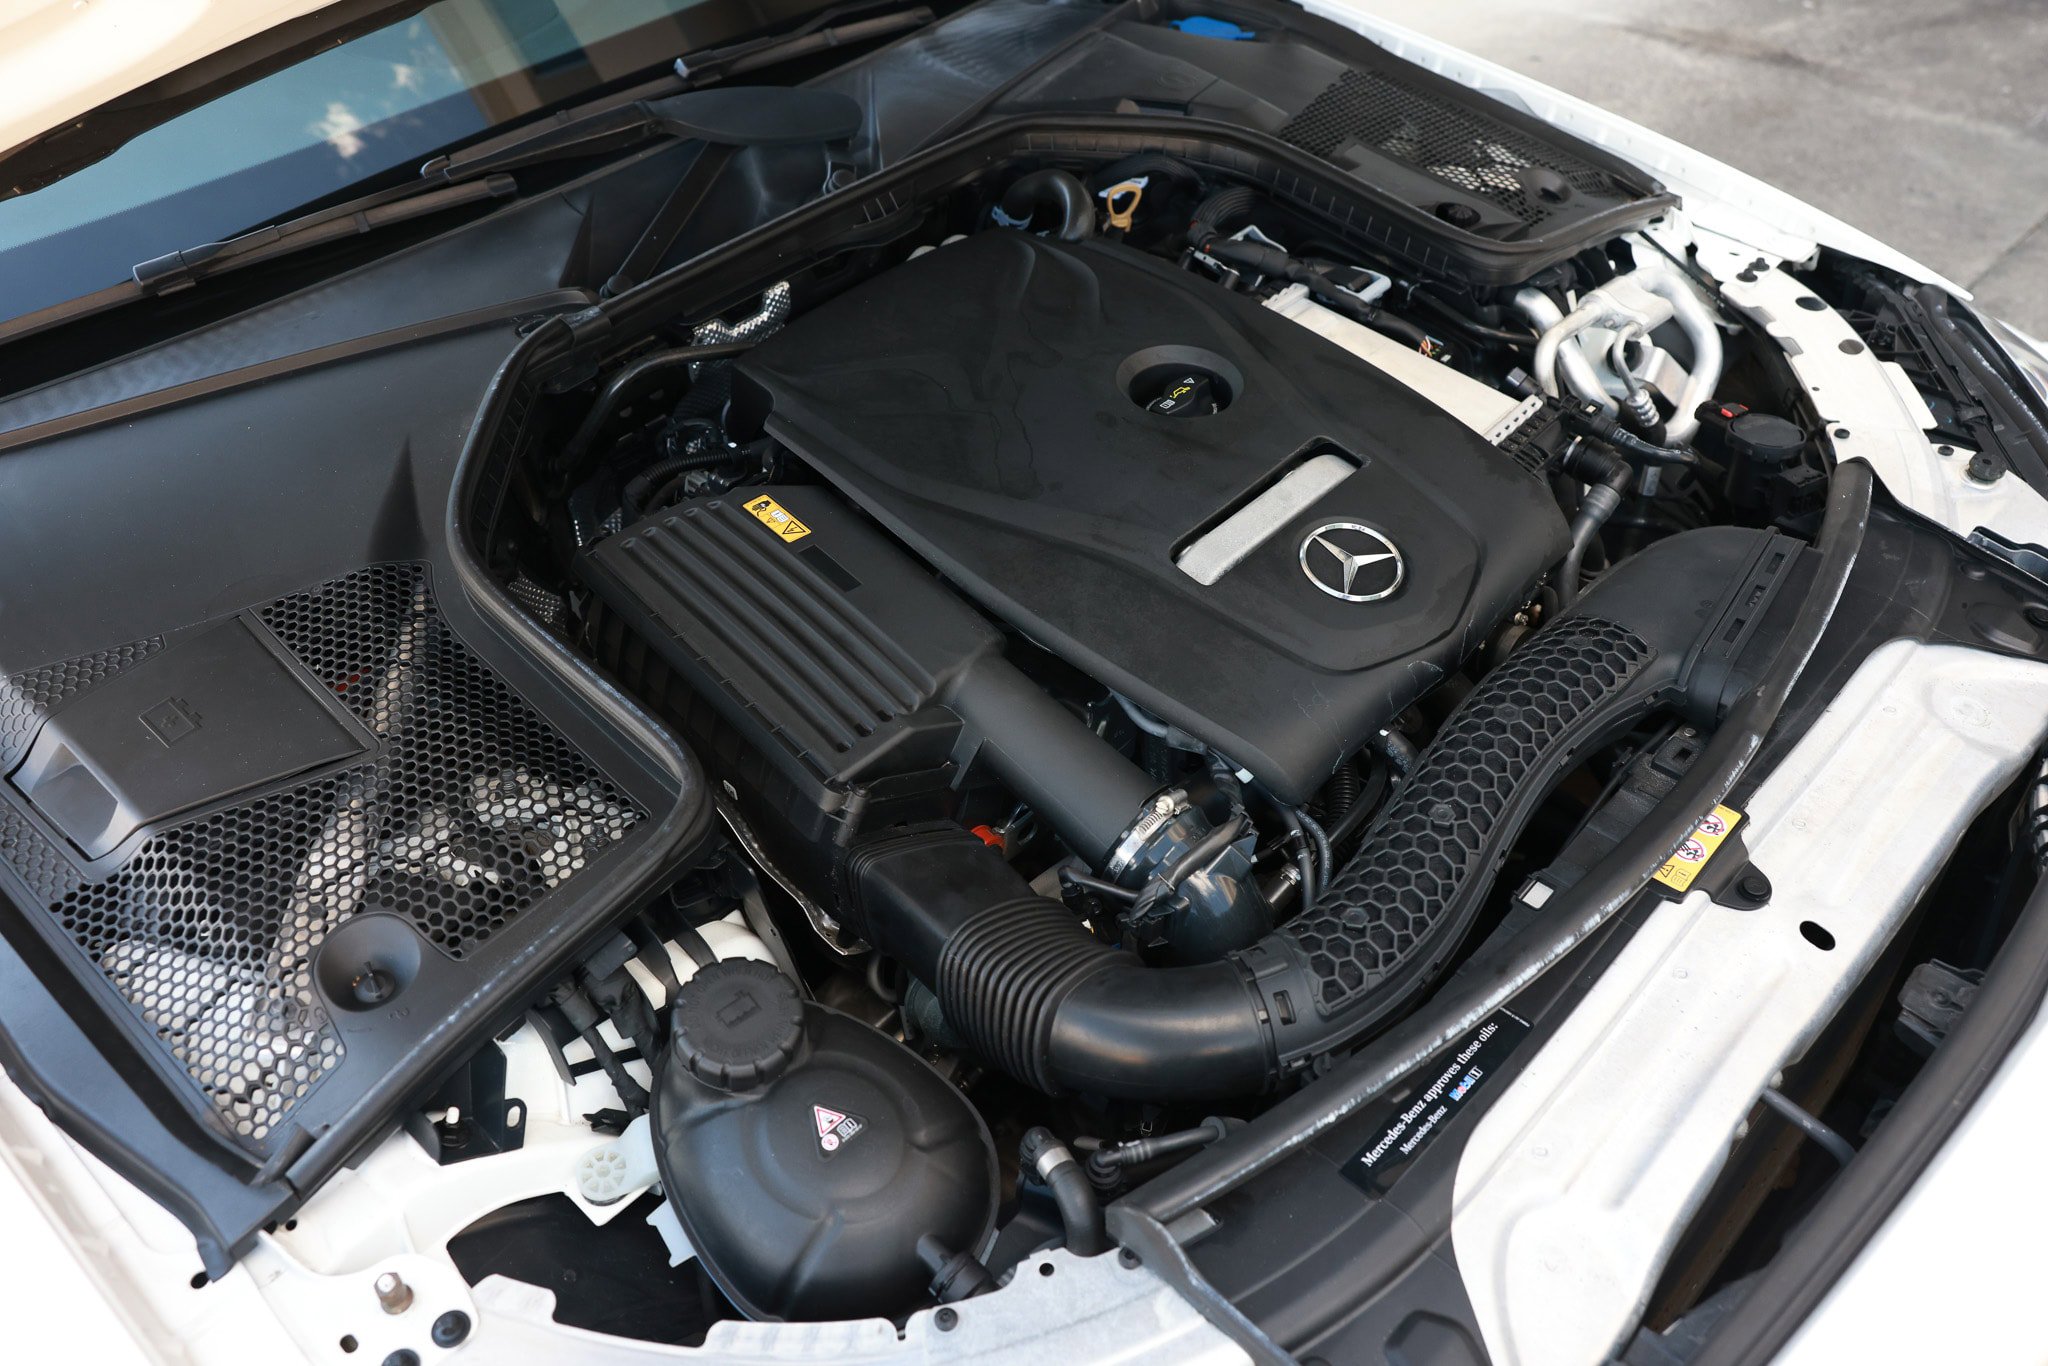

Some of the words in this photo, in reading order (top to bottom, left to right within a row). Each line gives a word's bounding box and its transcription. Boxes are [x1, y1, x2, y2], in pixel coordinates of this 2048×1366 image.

[1360, 1099, 1427, 1167] Mercedes-Benz
[1424, 1062, 1461, 1103] approves
[1456, 1040, 1482, 1065] these
[1479, 1022, 1499, 1042] oils:
[1399, 1105, 1448, 1155] Mercedes-Benz
[1448, 1075, 1476, 1102] Mobil
